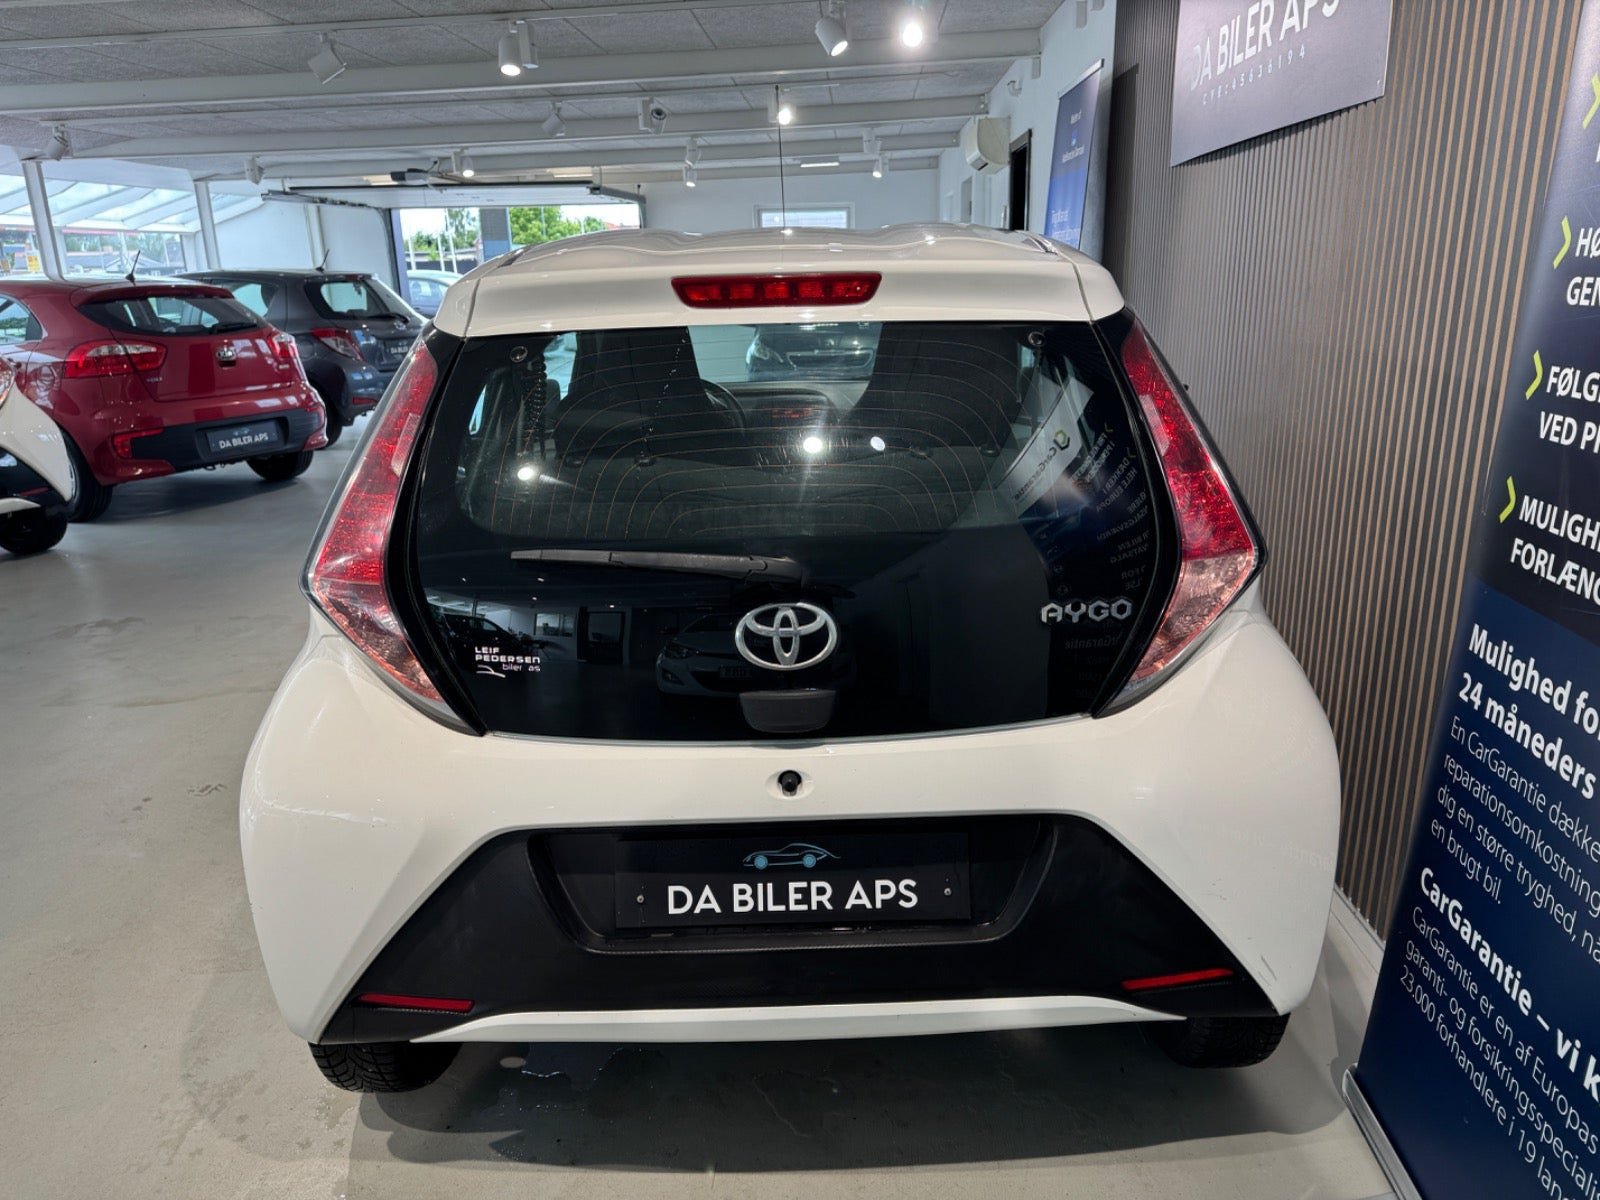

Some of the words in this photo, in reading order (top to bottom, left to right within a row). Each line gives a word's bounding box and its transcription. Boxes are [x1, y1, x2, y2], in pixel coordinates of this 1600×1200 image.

[1216, 0, 1275, 76] BILER
[1546, 365, 1600, 404] FØLG
[219, 440, 232, 449] DA
[232, 435, 253, 447] BILER
[254, 432, 269, 442] APS
[1539, 411, 1578, 446] VED
[1518, 494, 1600, 553] MULIGH
[1040, 598, 1132, 624] AYGO
[475, 646, 500, 654] LEIF
[475, 654, 541, 664] PEDERSEN
[502, 663, 523, 671] biler
[1468, 623, 1573, 715] Mulighed
[1573, 690, 1600, 741] fo
[1450, 715, 1466, 745] En
[1467, 731, 1547, 814] CarGarantie
[1458, 672, 1484, 711] 24
[1484, 696, 1597, 800] måneders
[667, 884, 722, 915] DA
[733, 881, 833, 913] BILER
[845, 879, 919, 909] APS
[1431, 819, 1446, 843] en
[1447, 829, 1483, 882] brugt
[1482, 866, 1501, 905] bil.
[1437, 785, 1457, 819] dig
[1458, 807, 1474, 832] en
[1476, 824, 1515, 872] større
[1516, 860, 1577, 942] tryghed,
[1420, 867, 1532, 1016] CarGarantie
[1556, 1028, 1582, 1073] vi
[1412, 906, 1479, 1000] CarGarantie
[1479, 995, 1495, 1019] er
[1495, 1015, 1514, 1046] en
[1515, 1040, 1534, 1066] af
[1532, 1056, 1599, 1154] Europas
[1400, 965, 1436, 1022] 23.000
[1435, 1013, 1507, 1126] forhandlere
[1508, 1115, 1516, 1136] i
[1518, 1129, 1537, 1163] 19
[1537, 1155, 1577, 1200] lan
[1406, 940, 1449, 998] garanti-
[1449, 997, 1467, 1030] og
[1468, 1016, 1600, 1200] forsikringsspeciali
